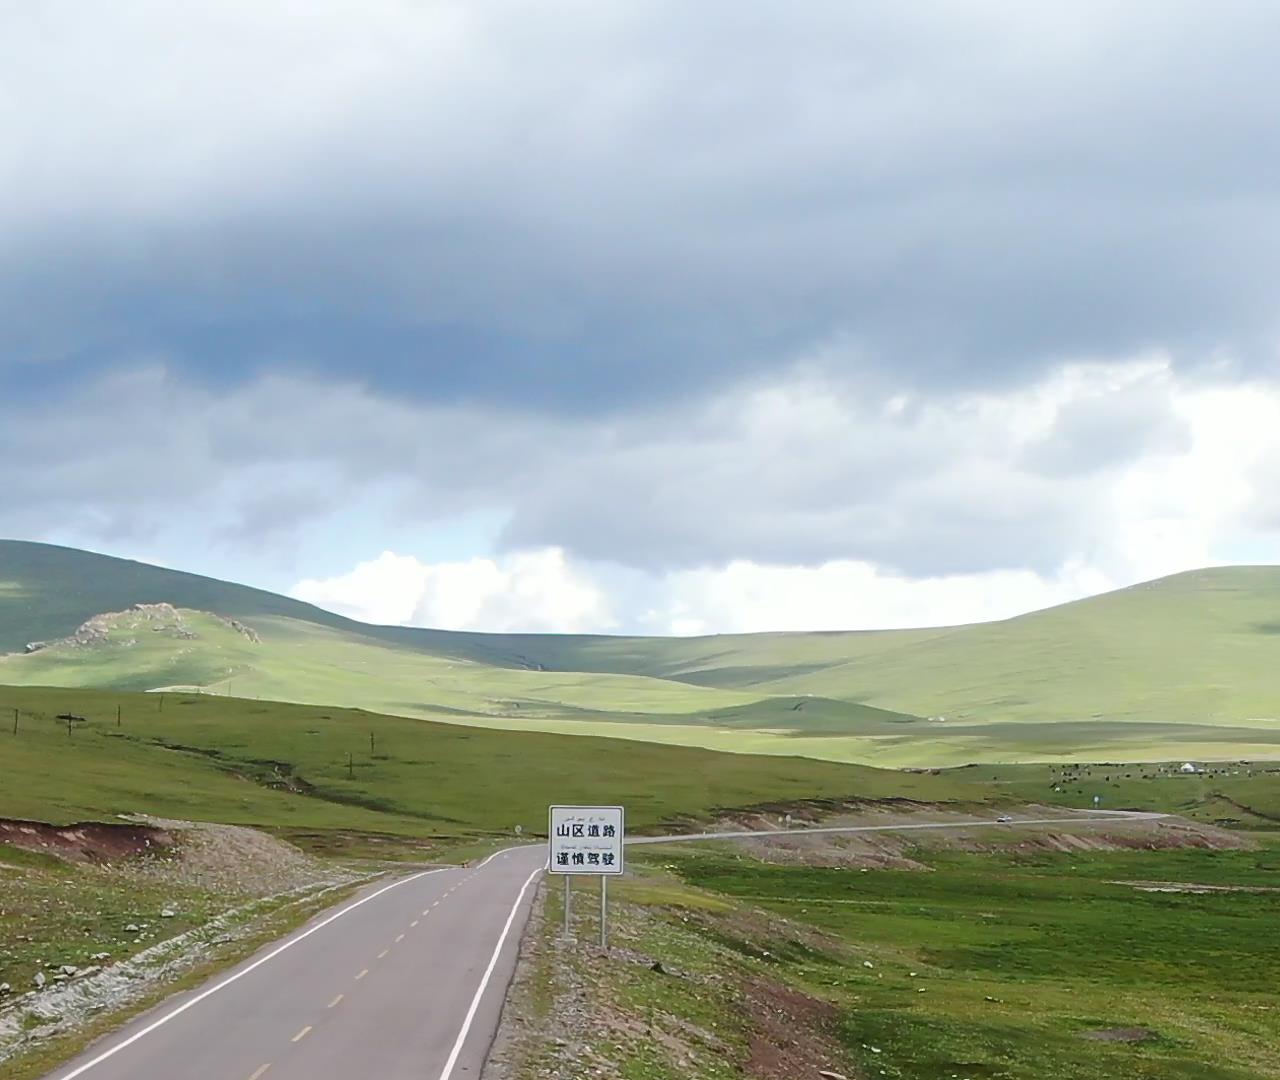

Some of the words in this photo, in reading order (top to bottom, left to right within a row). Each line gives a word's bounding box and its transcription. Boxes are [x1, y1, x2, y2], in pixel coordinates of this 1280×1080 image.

[556, 824, 615, 838] 山区道路
[556, 852, 615, 866] 谨慎驾驶
